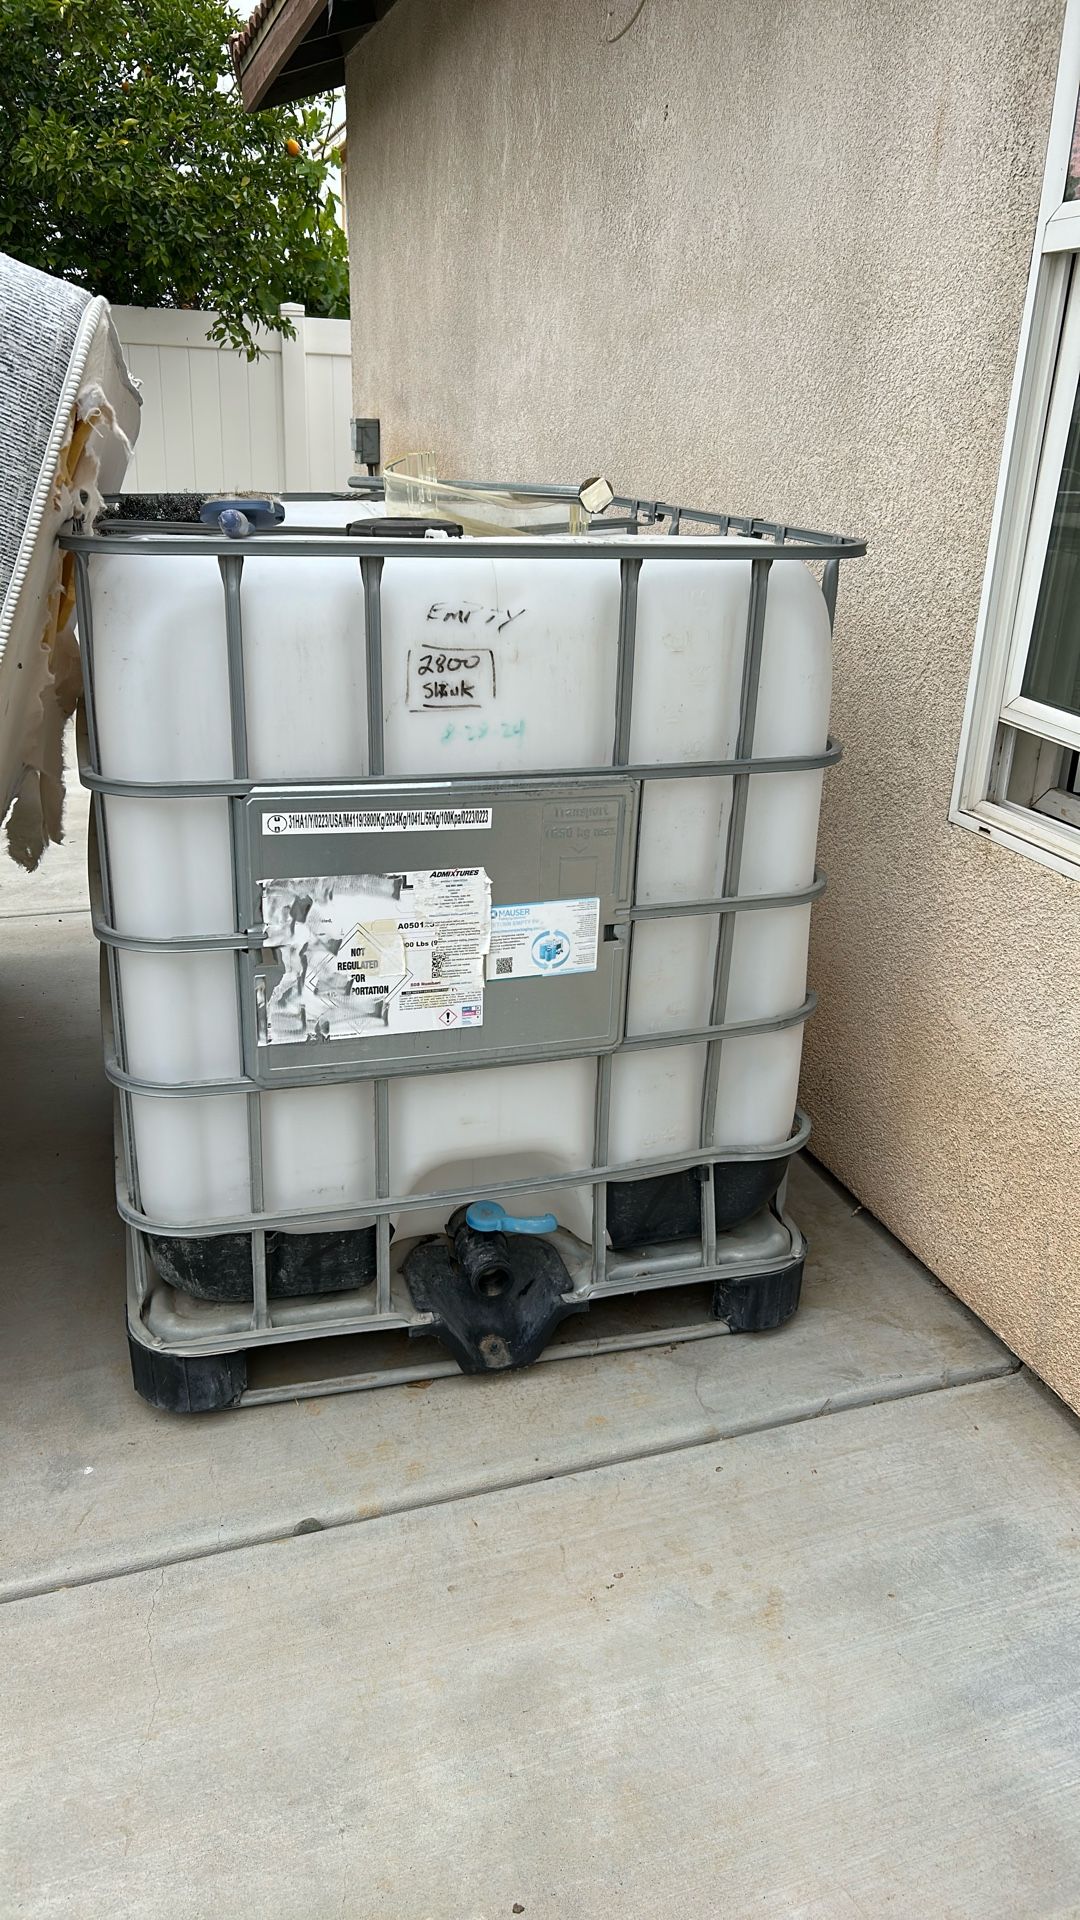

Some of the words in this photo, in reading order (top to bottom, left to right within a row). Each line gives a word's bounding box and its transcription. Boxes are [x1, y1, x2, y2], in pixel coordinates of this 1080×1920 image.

[418, 654, 480, 675] 2800
[498, 908, 530, 917] MAUSER
[350, 947, 365, 957] NOT
[337, 960, 379, 971] REGULATED
